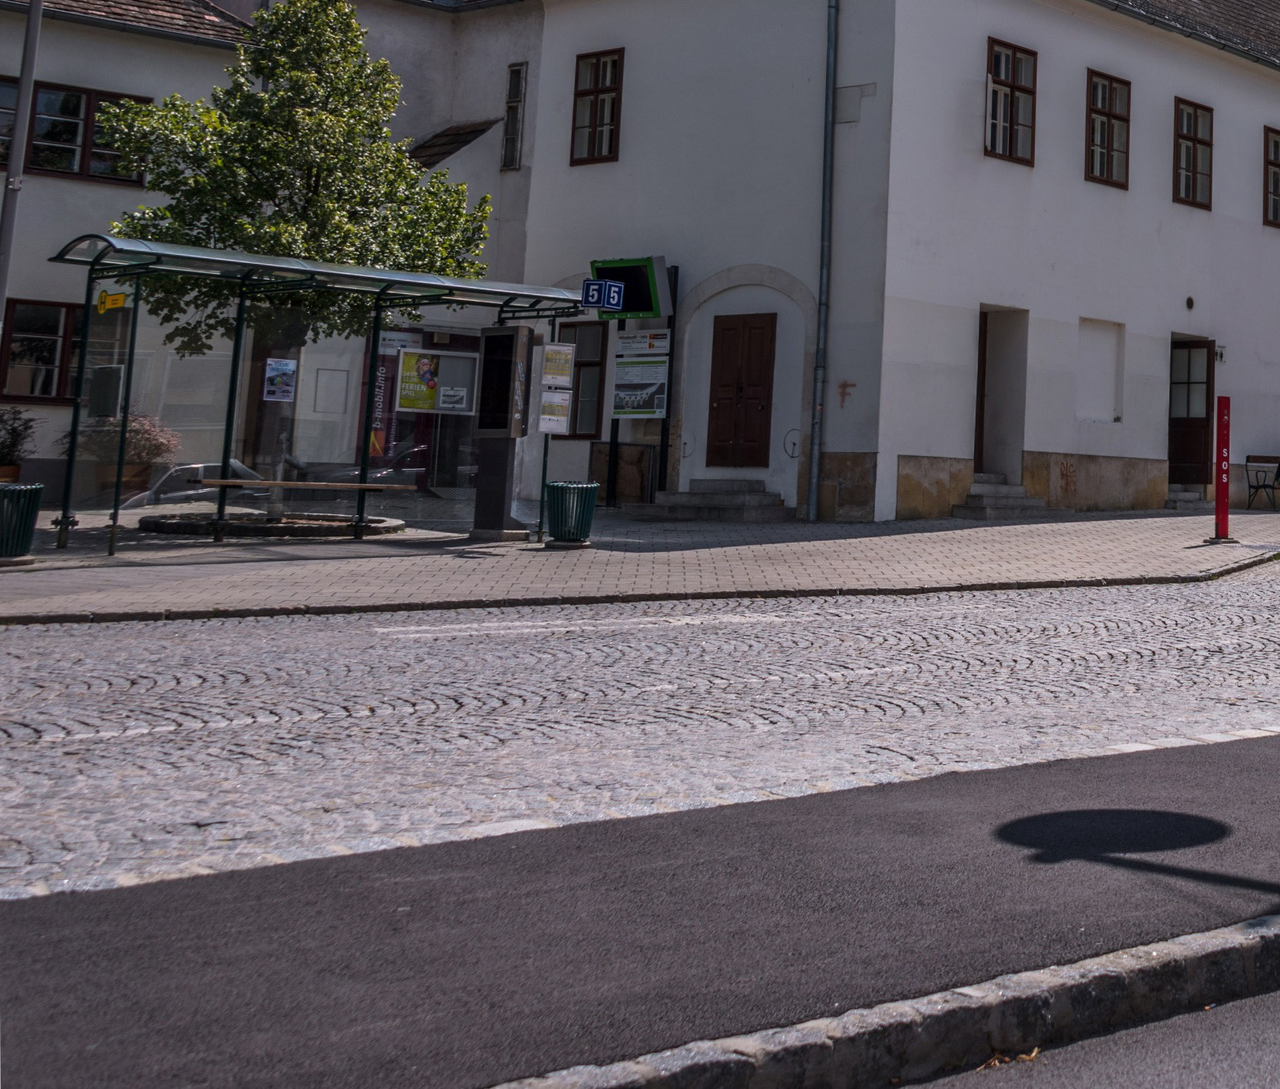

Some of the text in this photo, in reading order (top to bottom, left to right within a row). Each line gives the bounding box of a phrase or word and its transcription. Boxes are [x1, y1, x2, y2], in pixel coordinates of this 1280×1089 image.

[588, 285, 599, 302] 5
[609, 286, 619, 304] 5
[402, 383, 427, 391] FERIEN
[372, 366, 386, 429] b-mobil.info
